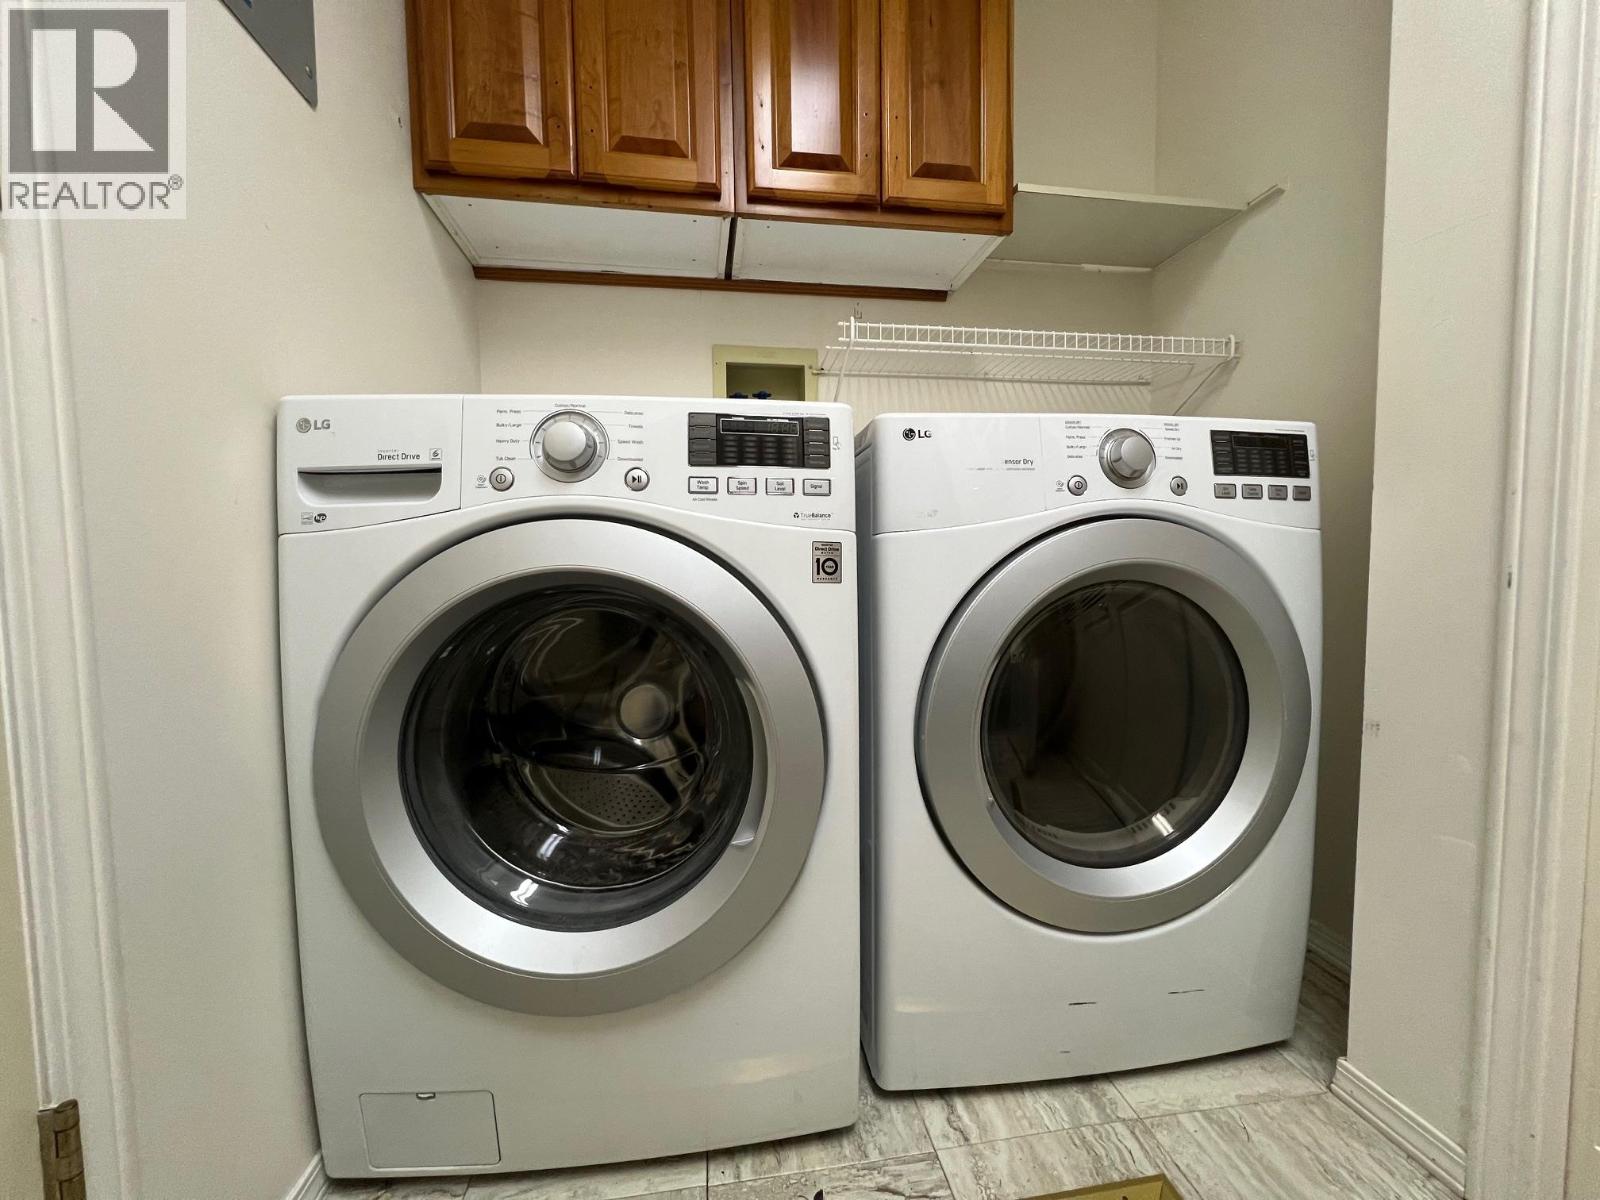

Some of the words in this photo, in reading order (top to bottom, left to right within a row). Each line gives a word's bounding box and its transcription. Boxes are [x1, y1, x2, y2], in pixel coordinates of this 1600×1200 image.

[313, 418, 331, 431] LG
[917, 428, 933, 439] LG
[377, 453, 400, 461] Direct
[401, 452, 421, 460] Drive
[1022, 458, 1034, 467] Dry
[815, 557, 839, 576] 10
